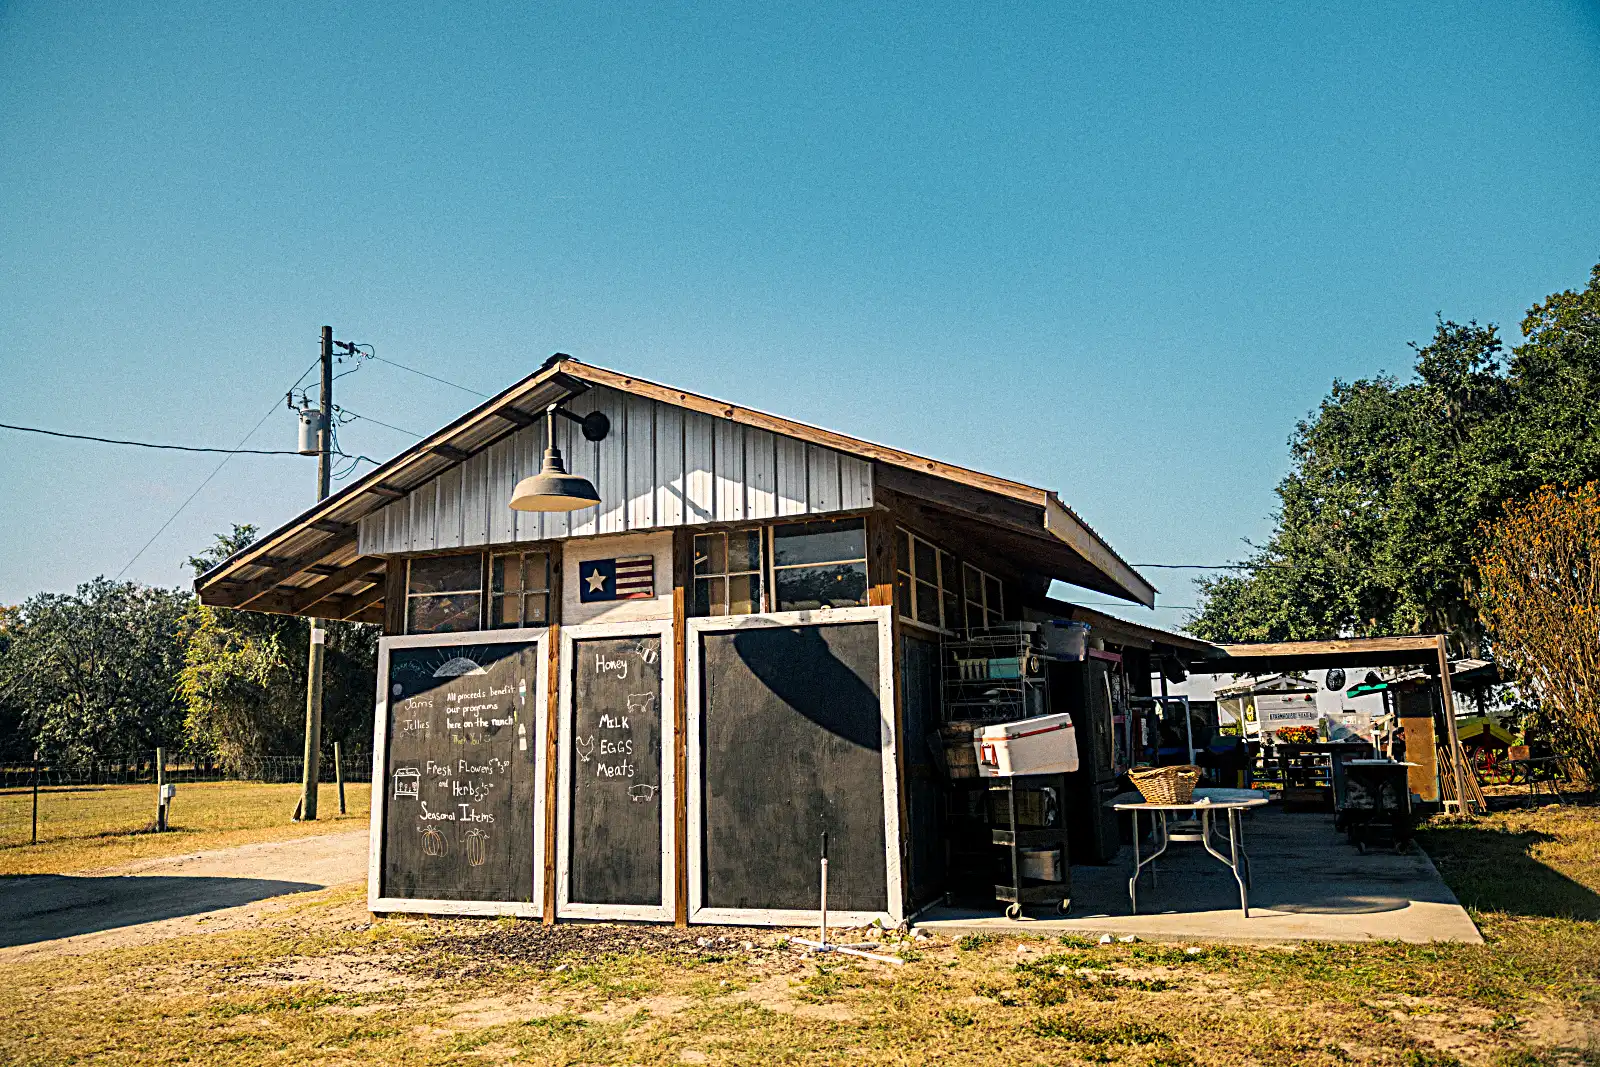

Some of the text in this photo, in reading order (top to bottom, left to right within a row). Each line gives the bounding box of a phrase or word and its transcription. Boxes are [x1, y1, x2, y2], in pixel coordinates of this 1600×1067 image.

[595, 654, 628, 680] Honey
[446, 684, 516, 704] All proceeds benefit
[404, 697, 433, 711] Jams
[446, 703, 499, 718] our programs
[403, 719, 430, 731] Jellies
[446, 715, 514, 729] here on the ranch
[599, 713, 630, 729] MILK
[600, 739, 633, 755] EGGS
[426, 760, 452, 776] Fresh
[596, 758, 635, 778] Meats
[438, 779, 449, 788] and
[452, 780, 480, 797] Herbs
[419, 800, 495, 823] Seasonal Items
